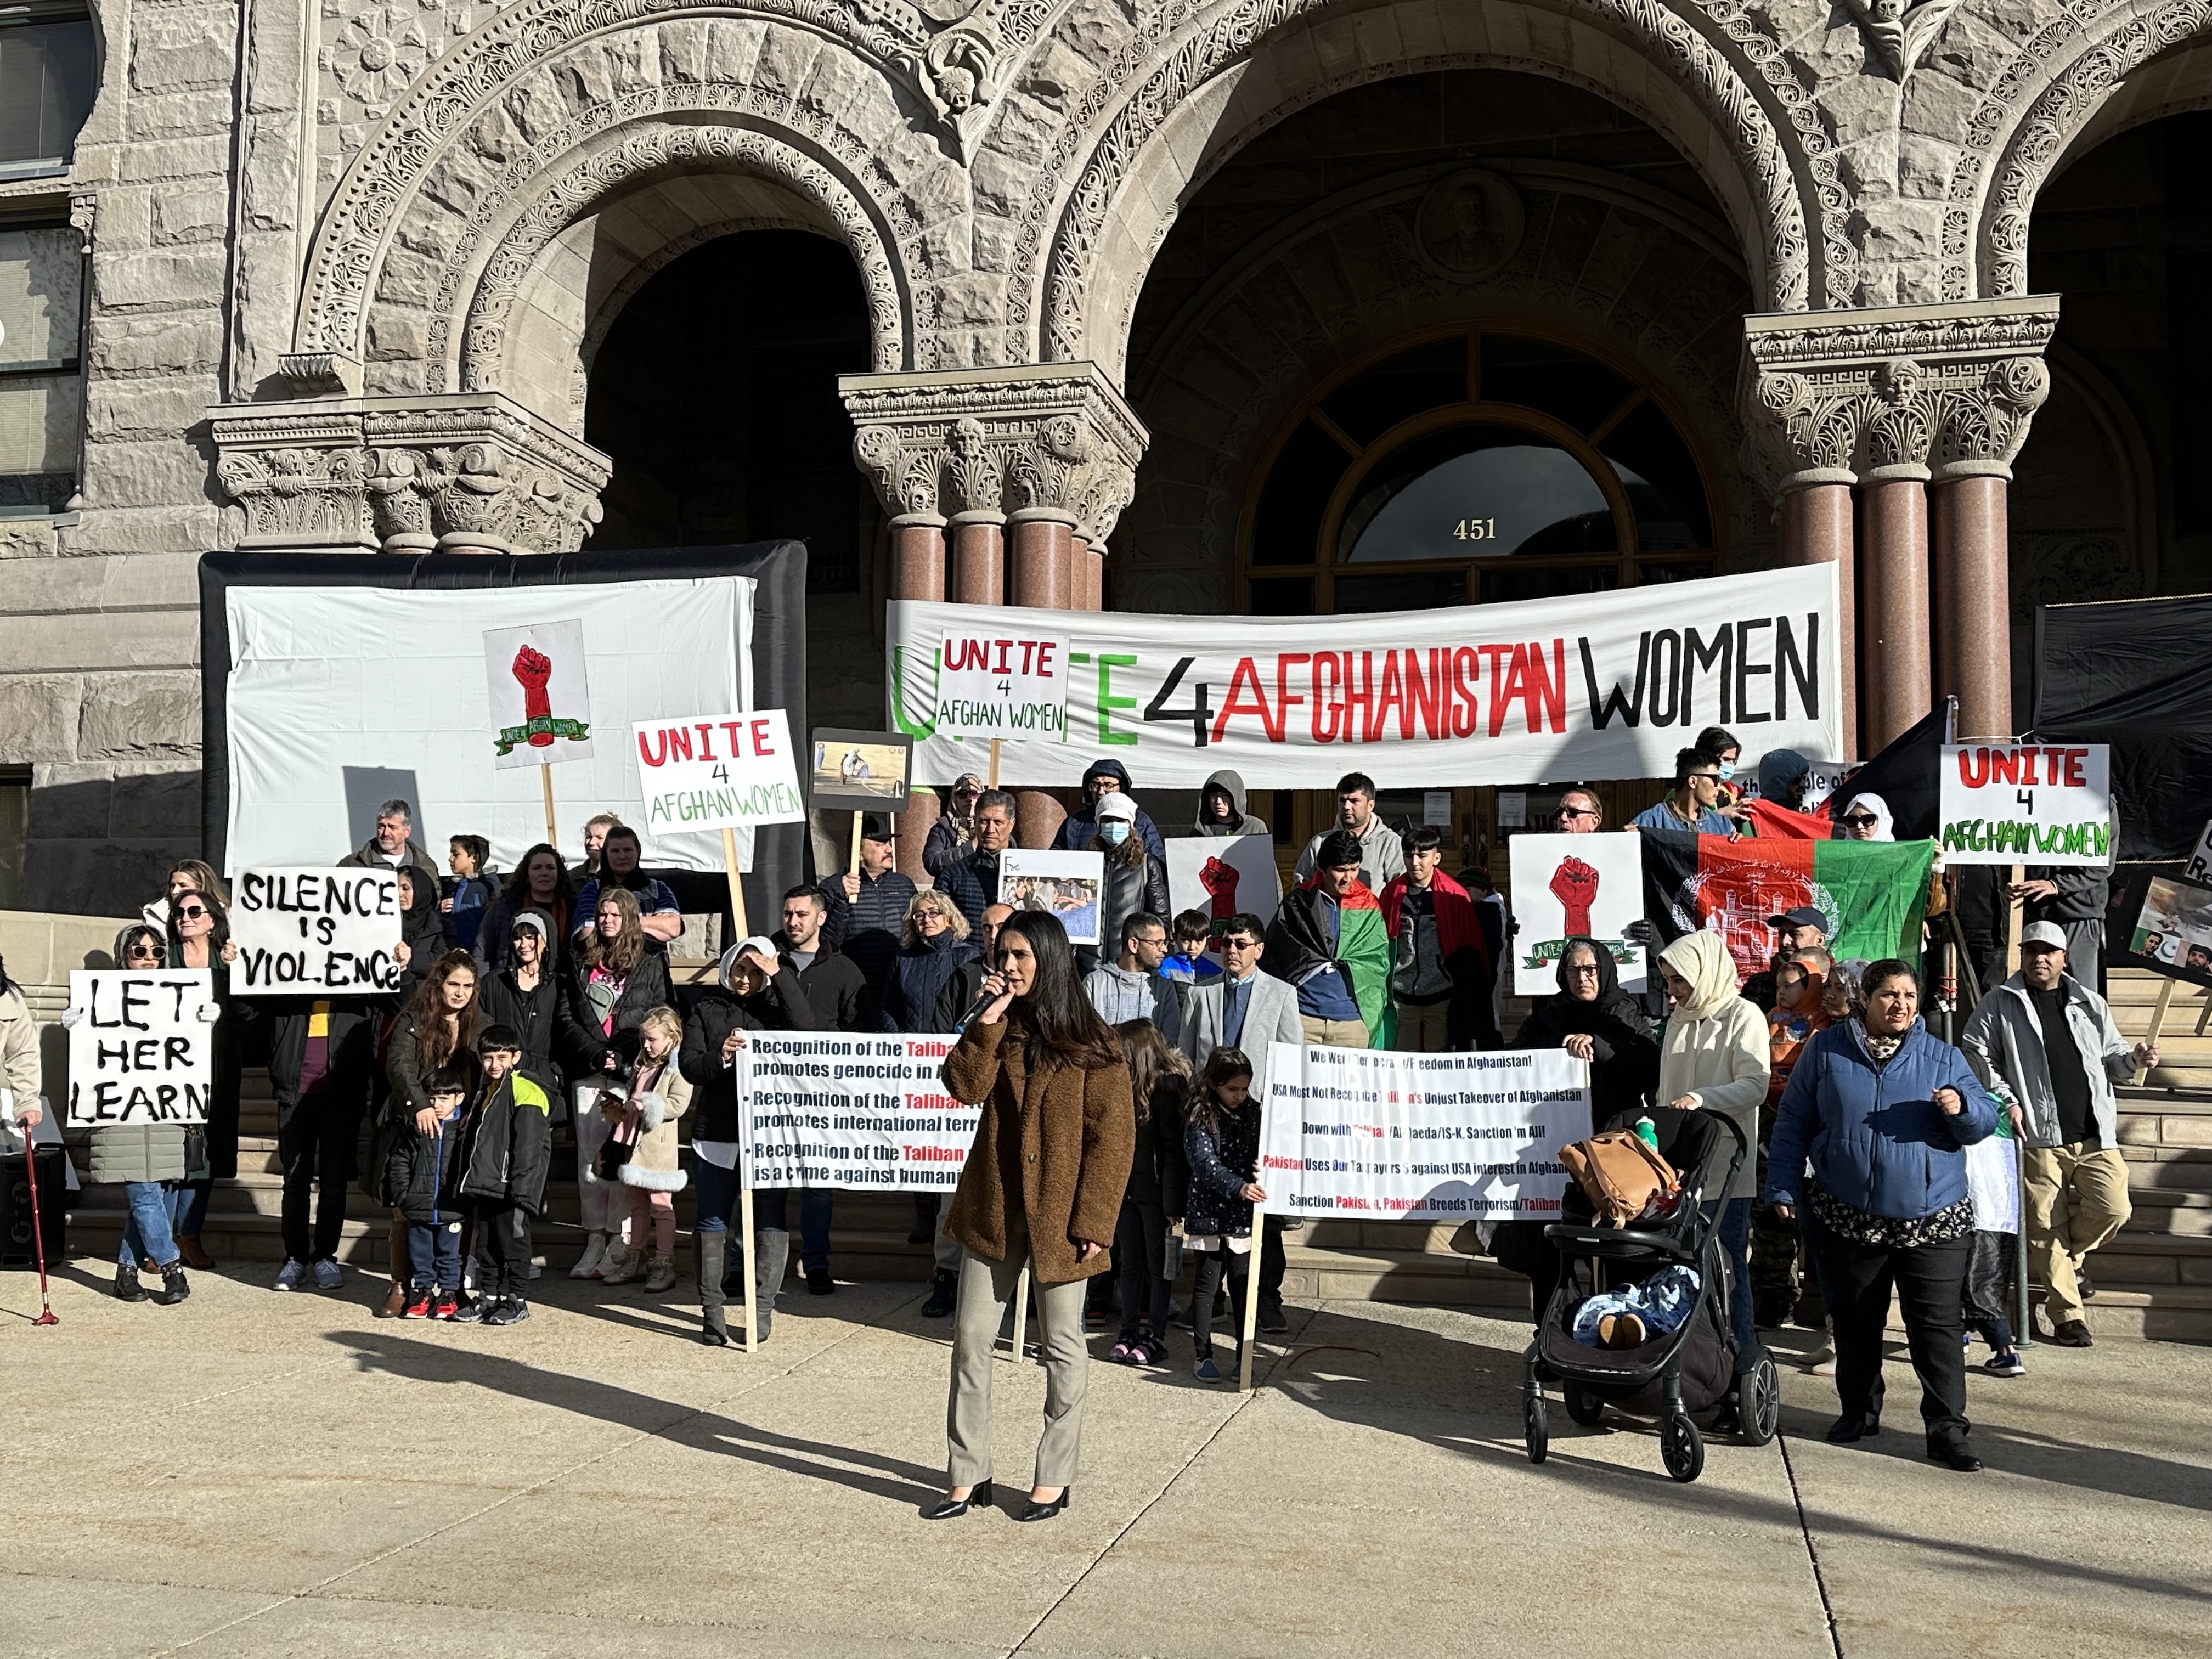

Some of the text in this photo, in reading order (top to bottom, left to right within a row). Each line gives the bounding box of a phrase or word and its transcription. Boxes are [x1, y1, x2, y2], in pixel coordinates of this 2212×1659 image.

[1453, 518, 1496, 540] 451
[944, 639, 1056, 678] UNITE
[997, 679, 1011, 697] 4
[1144, 657, 1214, 747] 4
[1211, 639, 1566, 743] AFGHANISTAN
[1578, 612, 1819, 730] WOMEN
[938, 699, 1063, 731] AFGHAN WOMEN
[638, 719, 775, 767] UNITE
[712, 764, 729, 784] 4
[1958, 747, 2089, 788] UNITE
[651, 783, 801, 823] AFGHAN WOMEN
[2017, 789, 2033, 815] 4
[1942, 819, 2109, 857] AFGHAN WOMEN
[240, 873, 396, 917] SILENCE
[299, 916, 336, 945] IS
[90, 979, 200, 1031] LET
[97, 1036, 194, 1074] HER
[752, 1039, 851, 1056] Recognition
[855, 1041, 872, 1056] of
[876, 1041, 902, 1057] the
[753, 1062, 830, 1077] promotes
[834, 1063, 912, 1080] genocide
[917, 1064, 932, 1079] in
[1310, 1051, 1325, 1063] We
[1455, 1057, 1464, 1069] in
[1467, 1055, 1532, 1070] Afghanistan!
[70, 1081, 210, 1124] LEARN
[753, 1091, 850, 1107] Recognition
[854, 1092, 871, 1108] of
[874, 1092, 900, 1109] the
[1272, 1083, 1288, 1097] USA
[1289, 1085, 1310, 1099] Must
[1312, 1086, 1328, 1099] Not
[1425, 1092, 1457, 1105] Unjust
[1458, 1091, 1505, 1104] Takeover
[1508, 1090, 1518, 1103] of
[1520, 1088, 1582, 1103] Afghanistan
[754, 1114, 830, 1130] promotes
[834, 1114, 942, 1132] international
[1302, 1122, 1329, 1135] Down
[1331, 1122, 1352, 1137] with
[1466, 1126, 1512, 1139] Sanction
[1529, 1125, 1546, 1138] All!
[755, 1143, 964, 1161] Recognition of the Taliban
[755, 1166, 770, 1181] is
[772, 1167, 782, 1180] a
[834, 1166, 895, 1183] against
[1262, 1155, 1304, 1171] Pakistan
[1305, 1158, 1330, 1171] Uses
[1332, 1159, 1350, 1172] Our
[1411, 1162, 1449, 1175] against
[1452, 1162, 1470, 1175] USA
[1474, 1161, 1515, 1175] interest
[1516, 1161, 1526, 1175] in
[1289, 1193, 1333, 1208] Sanction
[1384, 1197, 1427, 1211] Pakistan
[1429, 1198, 1466, 1211] Breeds
